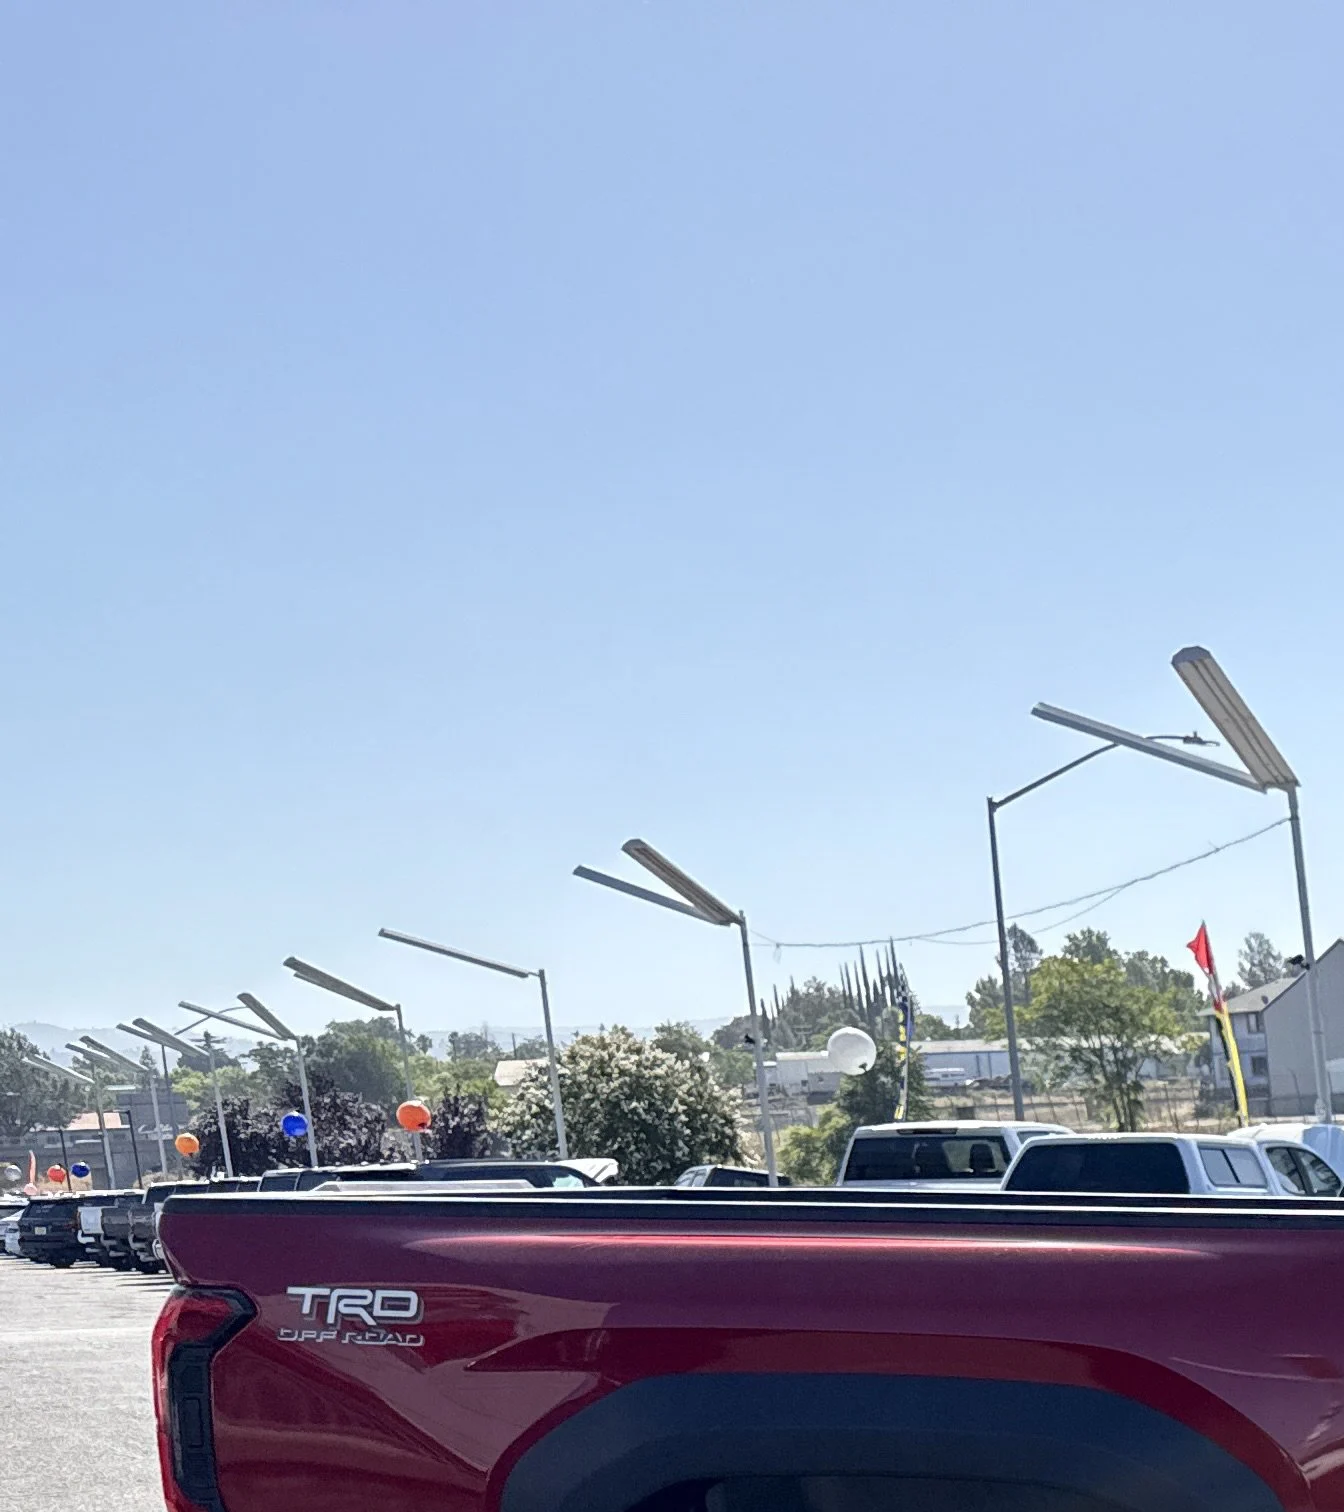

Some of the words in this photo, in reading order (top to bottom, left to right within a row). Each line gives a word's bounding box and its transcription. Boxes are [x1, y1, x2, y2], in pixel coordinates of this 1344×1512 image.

[286, 1286, 419, 1326] TRD
[277, 1327, 338, 1343] OFF
[341, 1331, 425, 1347] ROAD
